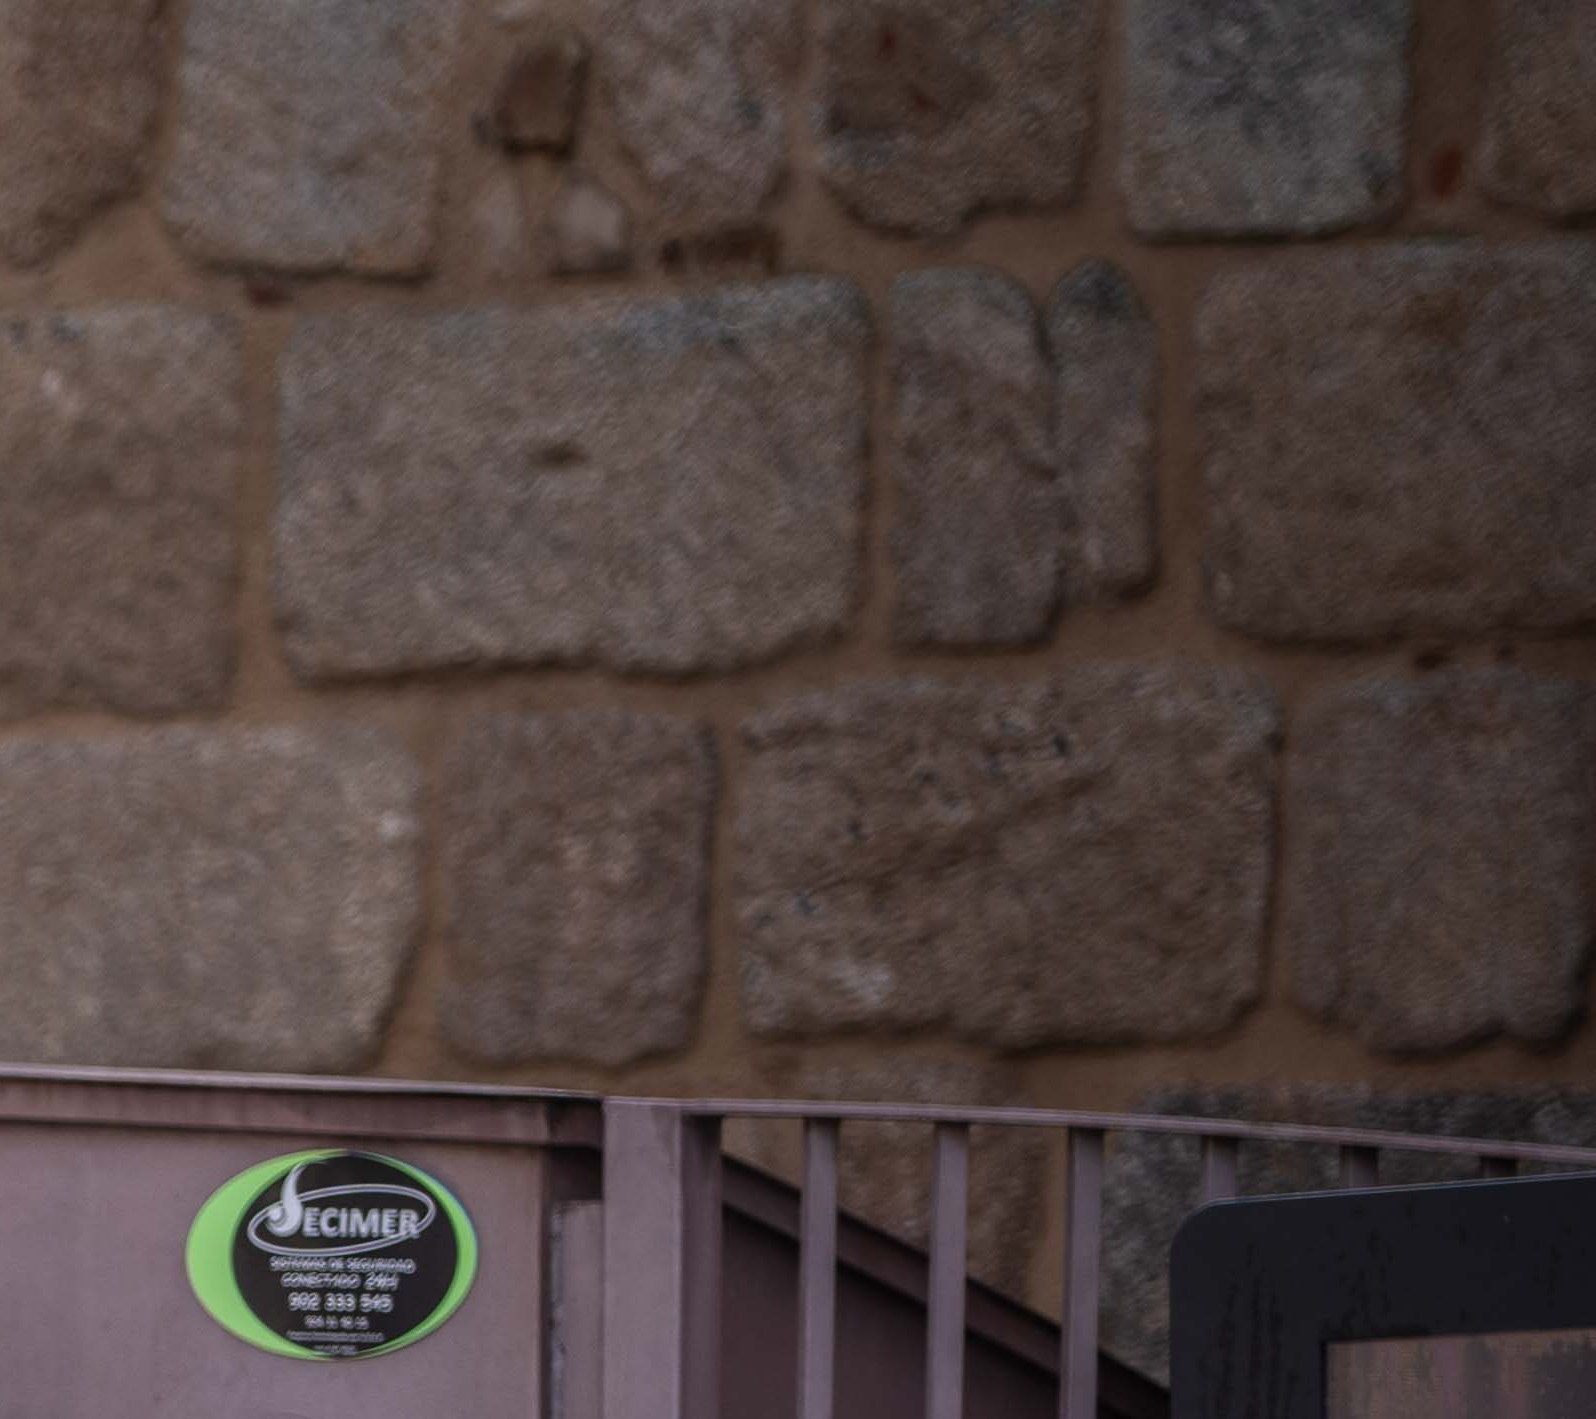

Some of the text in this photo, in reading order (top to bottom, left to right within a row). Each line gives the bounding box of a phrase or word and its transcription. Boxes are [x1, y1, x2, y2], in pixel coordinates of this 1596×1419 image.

[347, 1258, 416, 1274] SEGURIDAD
[288, 1292, 321, 1311] 902
[324, 1292, 356, 1312] 333
